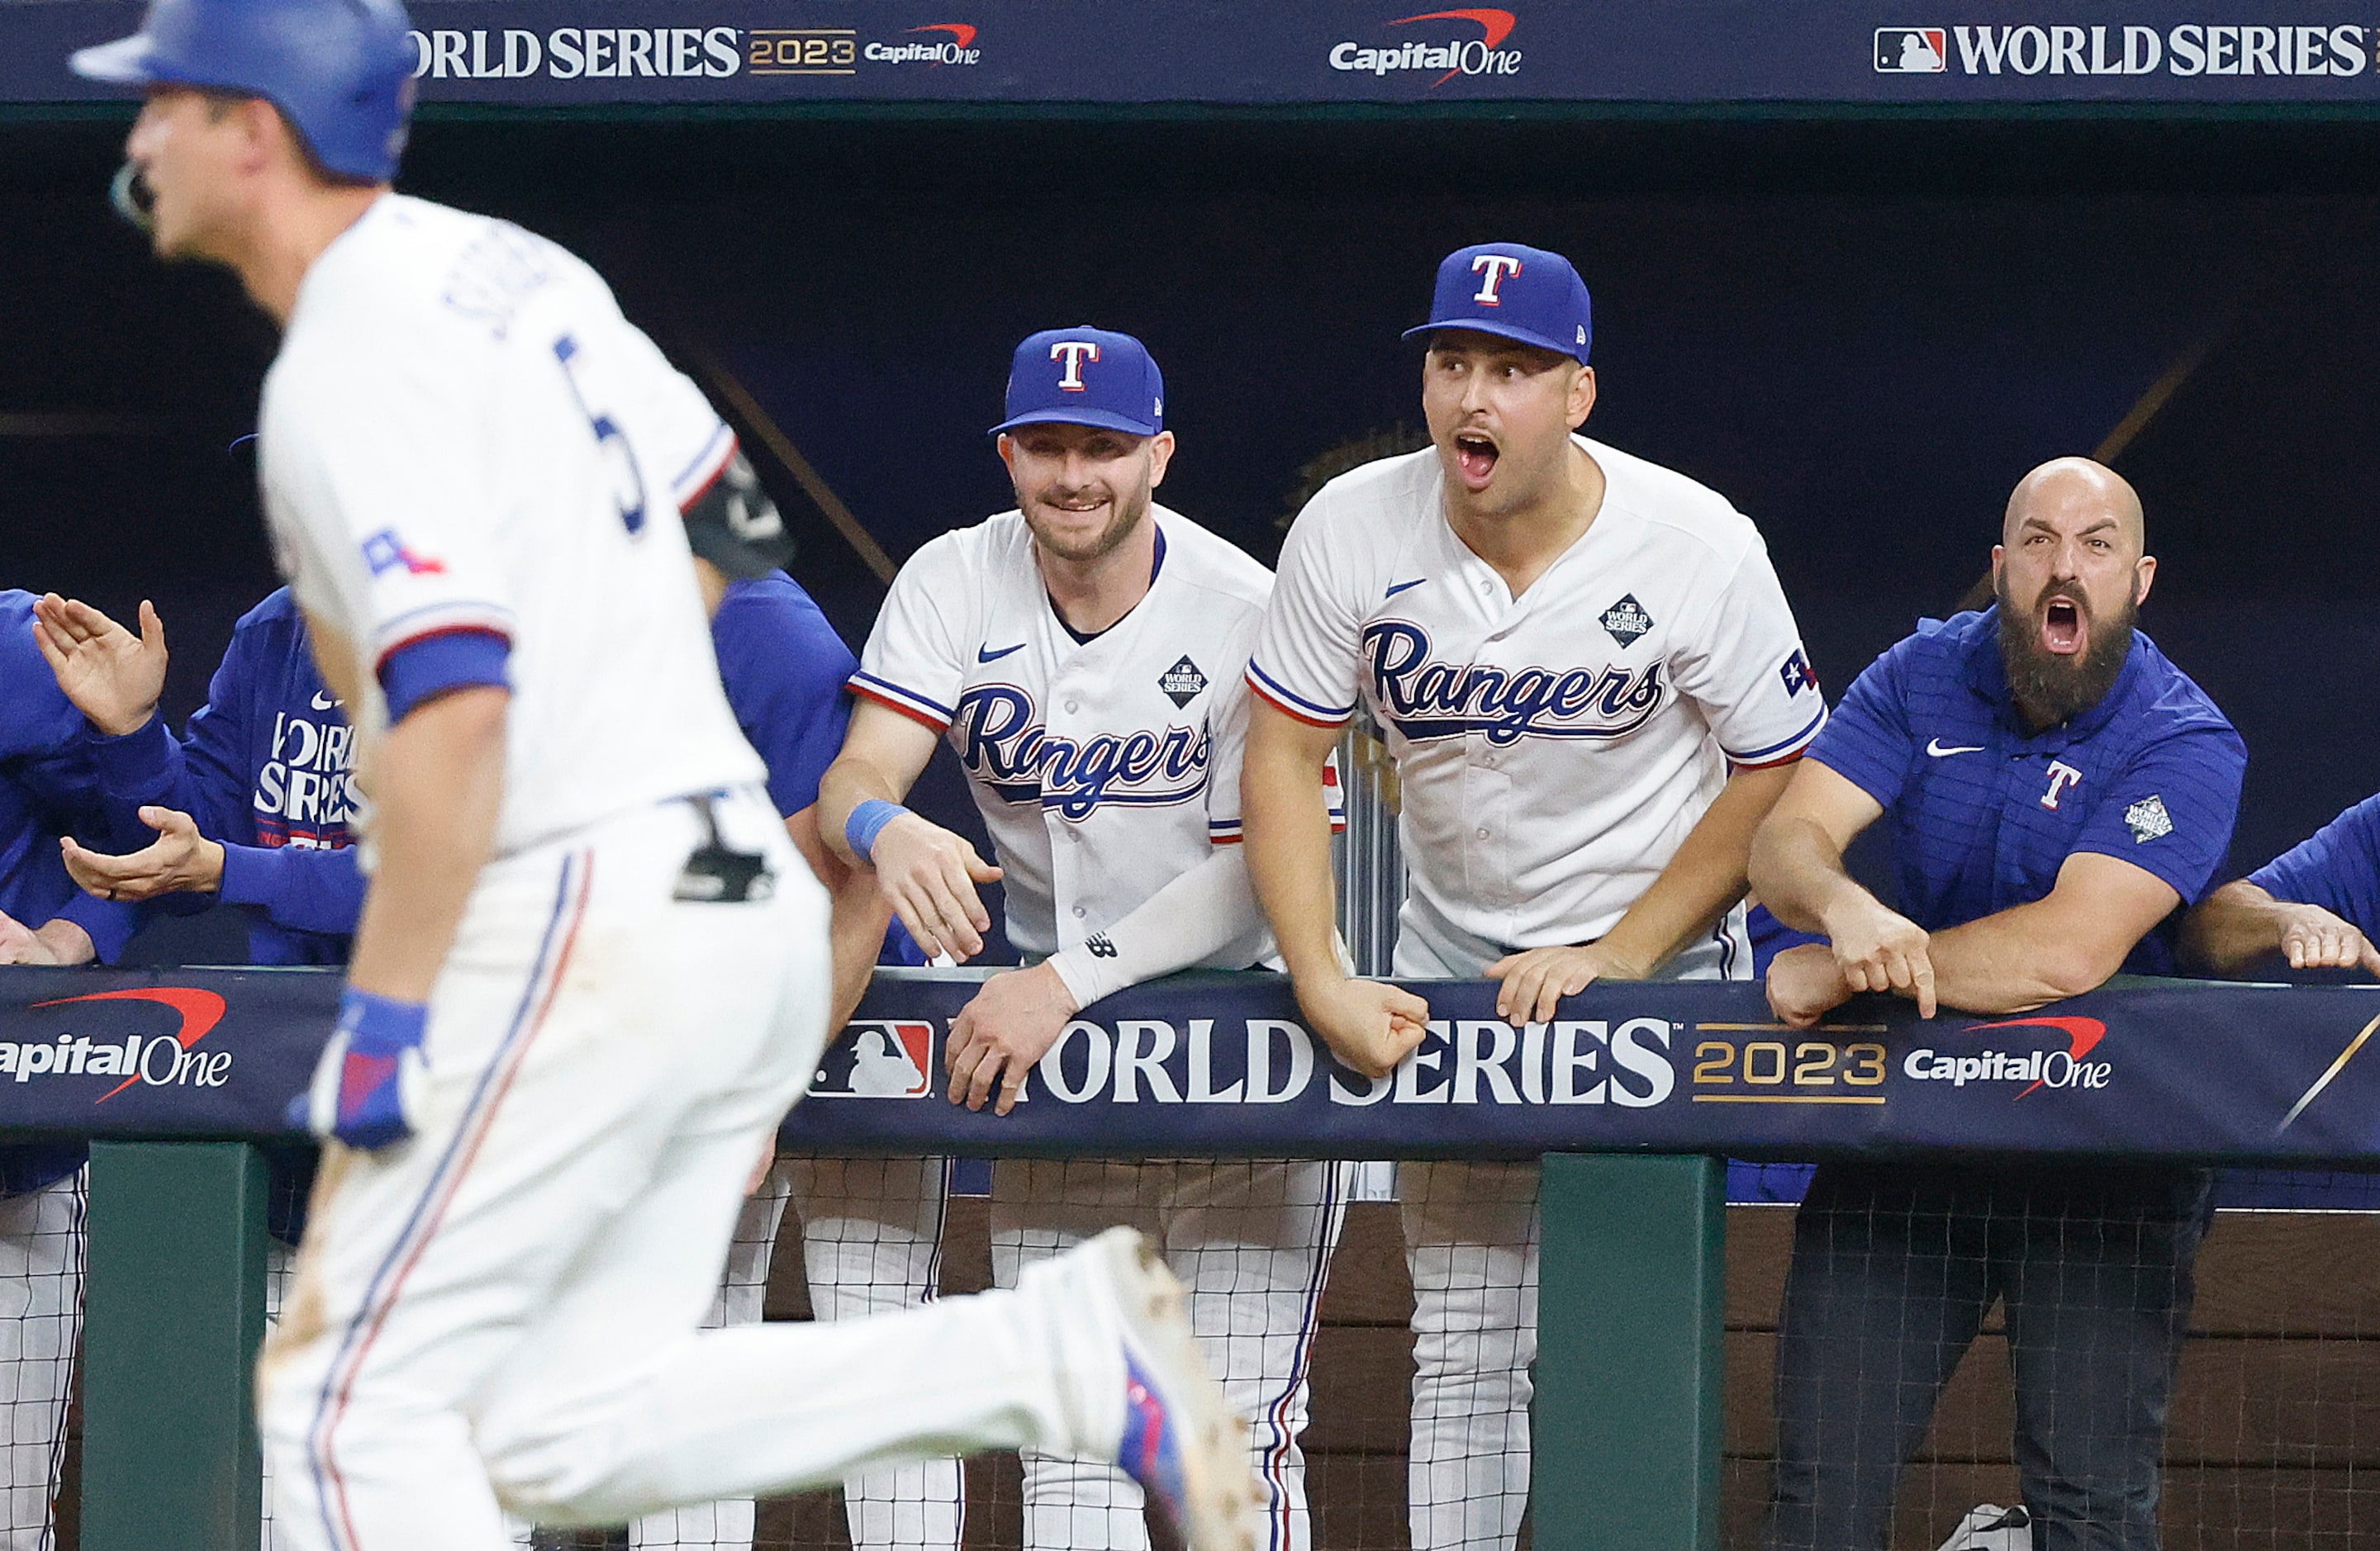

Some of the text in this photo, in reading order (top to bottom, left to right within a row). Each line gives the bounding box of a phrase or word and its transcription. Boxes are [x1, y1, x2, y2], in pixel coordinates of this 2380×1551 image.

[404, 27, 855, 79] ORLD SERIES 2023
[1953, 26, 2163, 76] WORLD
[2169, 25, 2367, 77] SERIES
[1471, 254, 1523, 306] T
[1050, 341, 1101, 391] T
[551, 332, 647, 537] 5
[1605, 619, 1647, 633] SERIES
[1606, 610, 1648, 624] WORLD
[1163, 682, 1202, 692] SERIES
[1165, 673, 1202, 683] WORLD
[1361, 618, 1665, 747] Rangers
[960, 682, 1212, 822] Rangers
[2040, 760, 2083, 811] T
[947, 1017, 1314, 1103] ORLD
[1693, 1041, 1888, 1086] 2023
